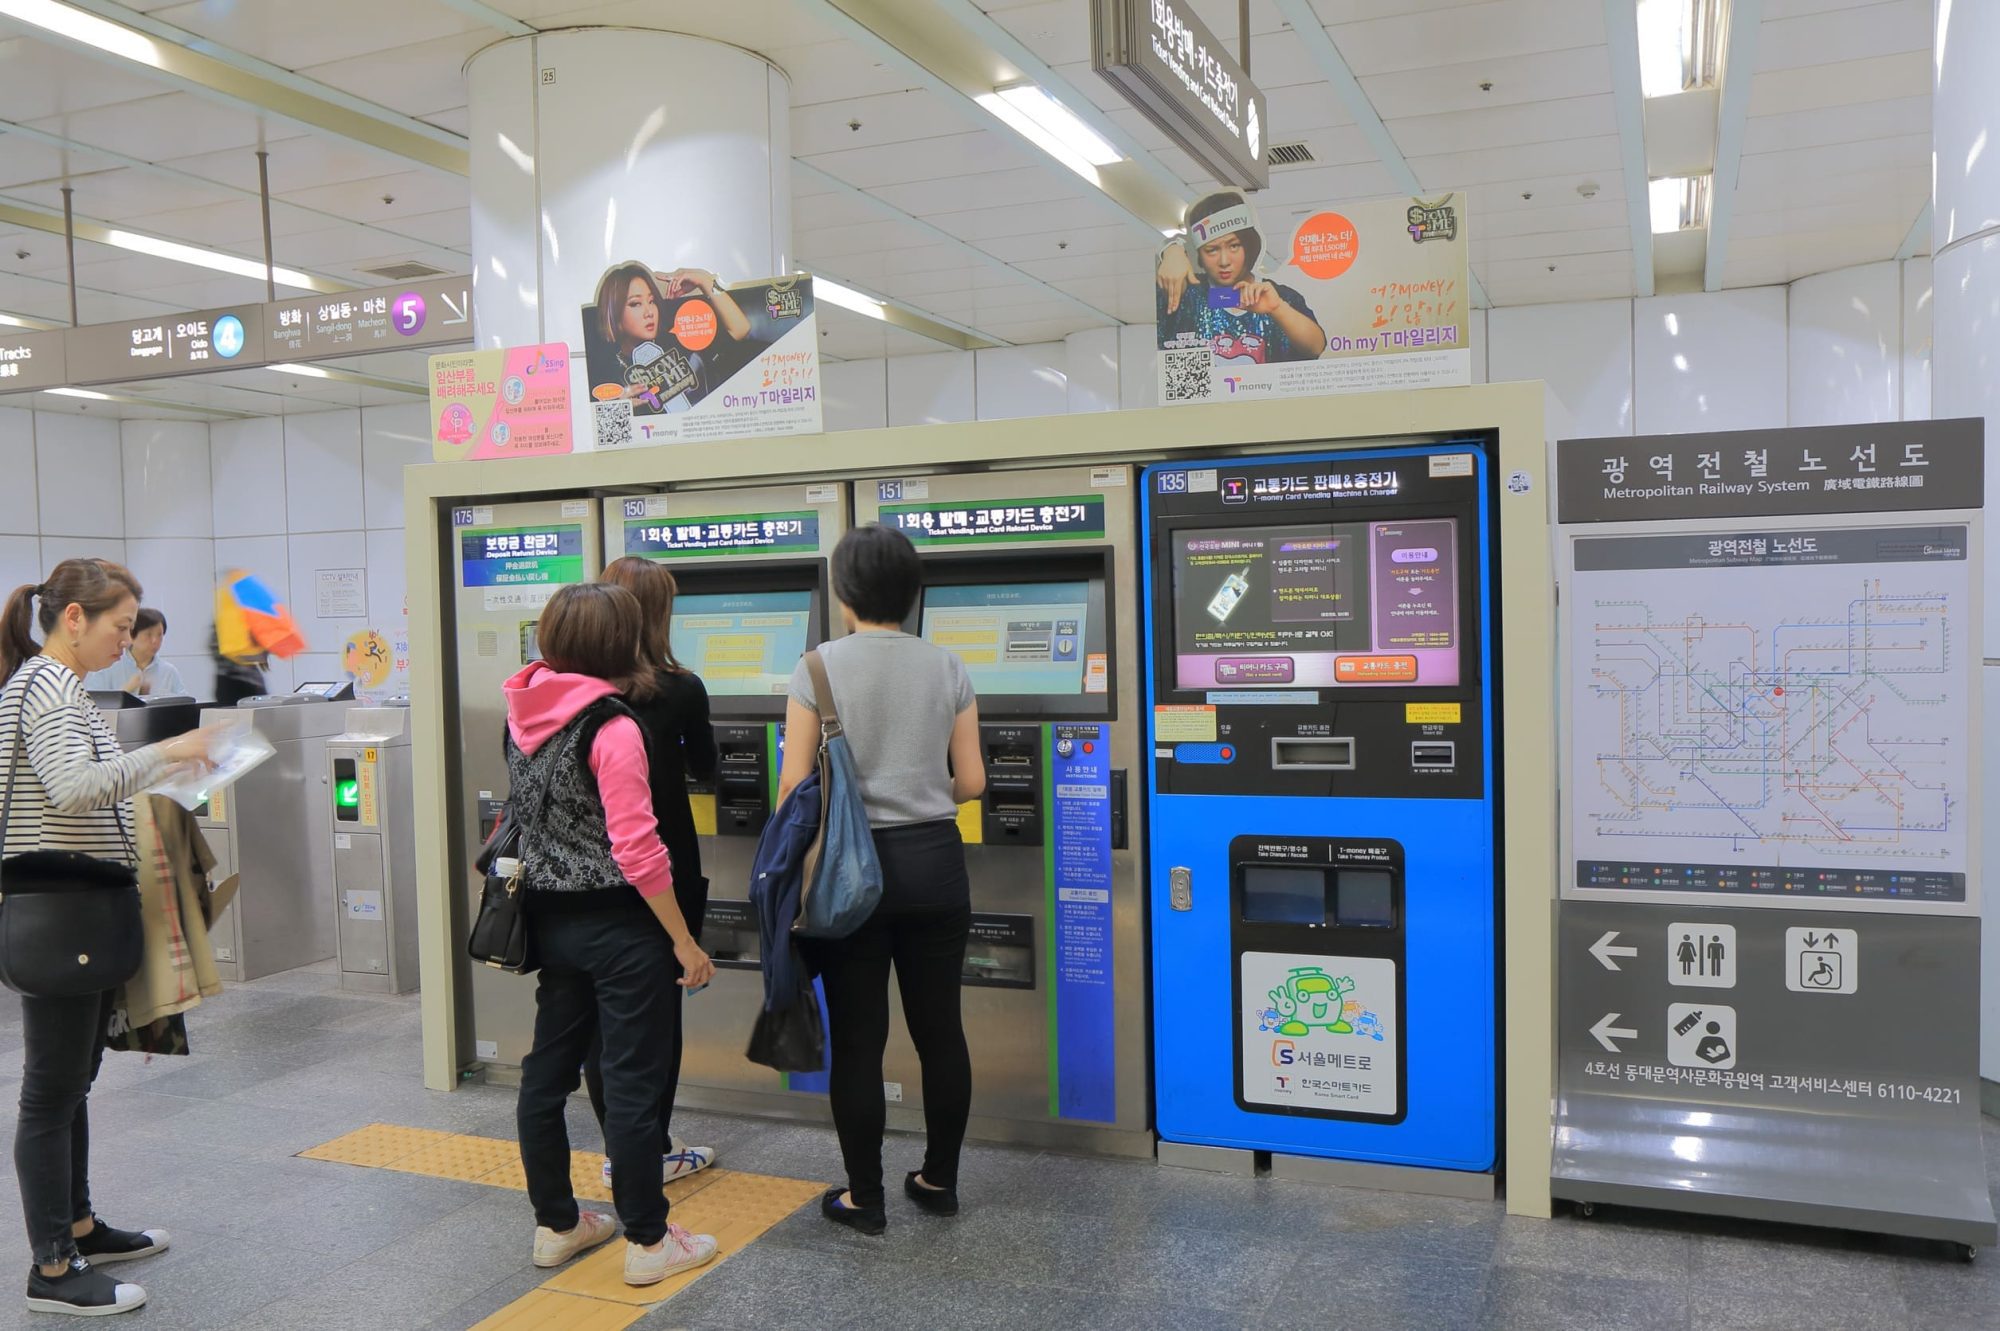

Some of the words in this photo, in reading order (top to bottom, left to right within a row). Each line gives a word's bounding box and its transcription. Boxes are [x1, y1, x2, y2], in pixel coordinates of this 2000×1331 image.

[543, 71, 554, 82] 25
[1168, 53, 1189, 91] Vending
[1190, 79, 1199, 97] and
[1200, 86, 1210, 109] Card
[363, 298, 387, 314] 마천
[280, 308, 302, 326] 방화
[402, 300, 417, 329] 5
[358, 317, 387, 329] Macheon
[132, 327, 163, 345] 당고개
[176, 321, 208, 338] 오이도
[220, 322, 236, 350] 4
[273, 328, 301, 340] Banghwa
[191, 340, 208, 349] Oido
[1330, 337, 1351, 352] Oh
[1357, 335, 1378, 353] my
[437, 369, 475, 384] 임산부를
[437, 382, 497, 398] 배려해주세요
[723, 395, 739, 408] Oh
[742, 394, 760, 409] my
[1159, 474, 1185, 491] 135
[1253, 476, 1309, 494] 교통카드
[1604, 485, 1694, 500] Metropolitan
[1700, 481, 1753, 497] Railway
[1758, 479, 1810, 495] System
[880, 483, 902, 499] 151
[1253, 494, 1284, 502] T-money
[1304, 492, 1331, 500] Vending
[1333, 490, 1361, 498] Machine
[1369, 489, 1398, 497] Charger
[456, 510, 473, 524] 175
[624, 502, 644, 516] 150
[897, 513, 935, 529] 1회용
[1039, 504, 1086, 523] 충전기
[640, 527, 672, 542] 1회용
[762, 520, 802, 537] 충전기
[928, 527, 947, 535] Ticket
[948, 526, 975, 535] Vending
[989, 525, 1005, 533] Card
[1030, 523, 1053, 531] Device
[486, 536, 520, 551] 보증금
[667, 541, 683, 549] Ticket
[684, 540, 707, 549] Vending
[1708, 539, 1766, 557] 광역전철
[1772, 537, 1818, 554] 노선도
[487, 551, 511, 559] Deposit
[536, 548, 558, 556] Device
[1401, 551, 1428, 559] 이용안내
[1362, 662, 1391, 670] 교통카드
[1340, 847, 1366, 855] T-money
[1298, 1051, 1372, 1071] 서울메트로
[1585, 1061, 1620, 1080] 4호선
[1624, 1064, 1765, 1091] 동대문역사문화공원역
[1768, 1073, 1872, 1098] 고객서비스센터
[1877, 1083, 1961, 1105] 6110-4221
